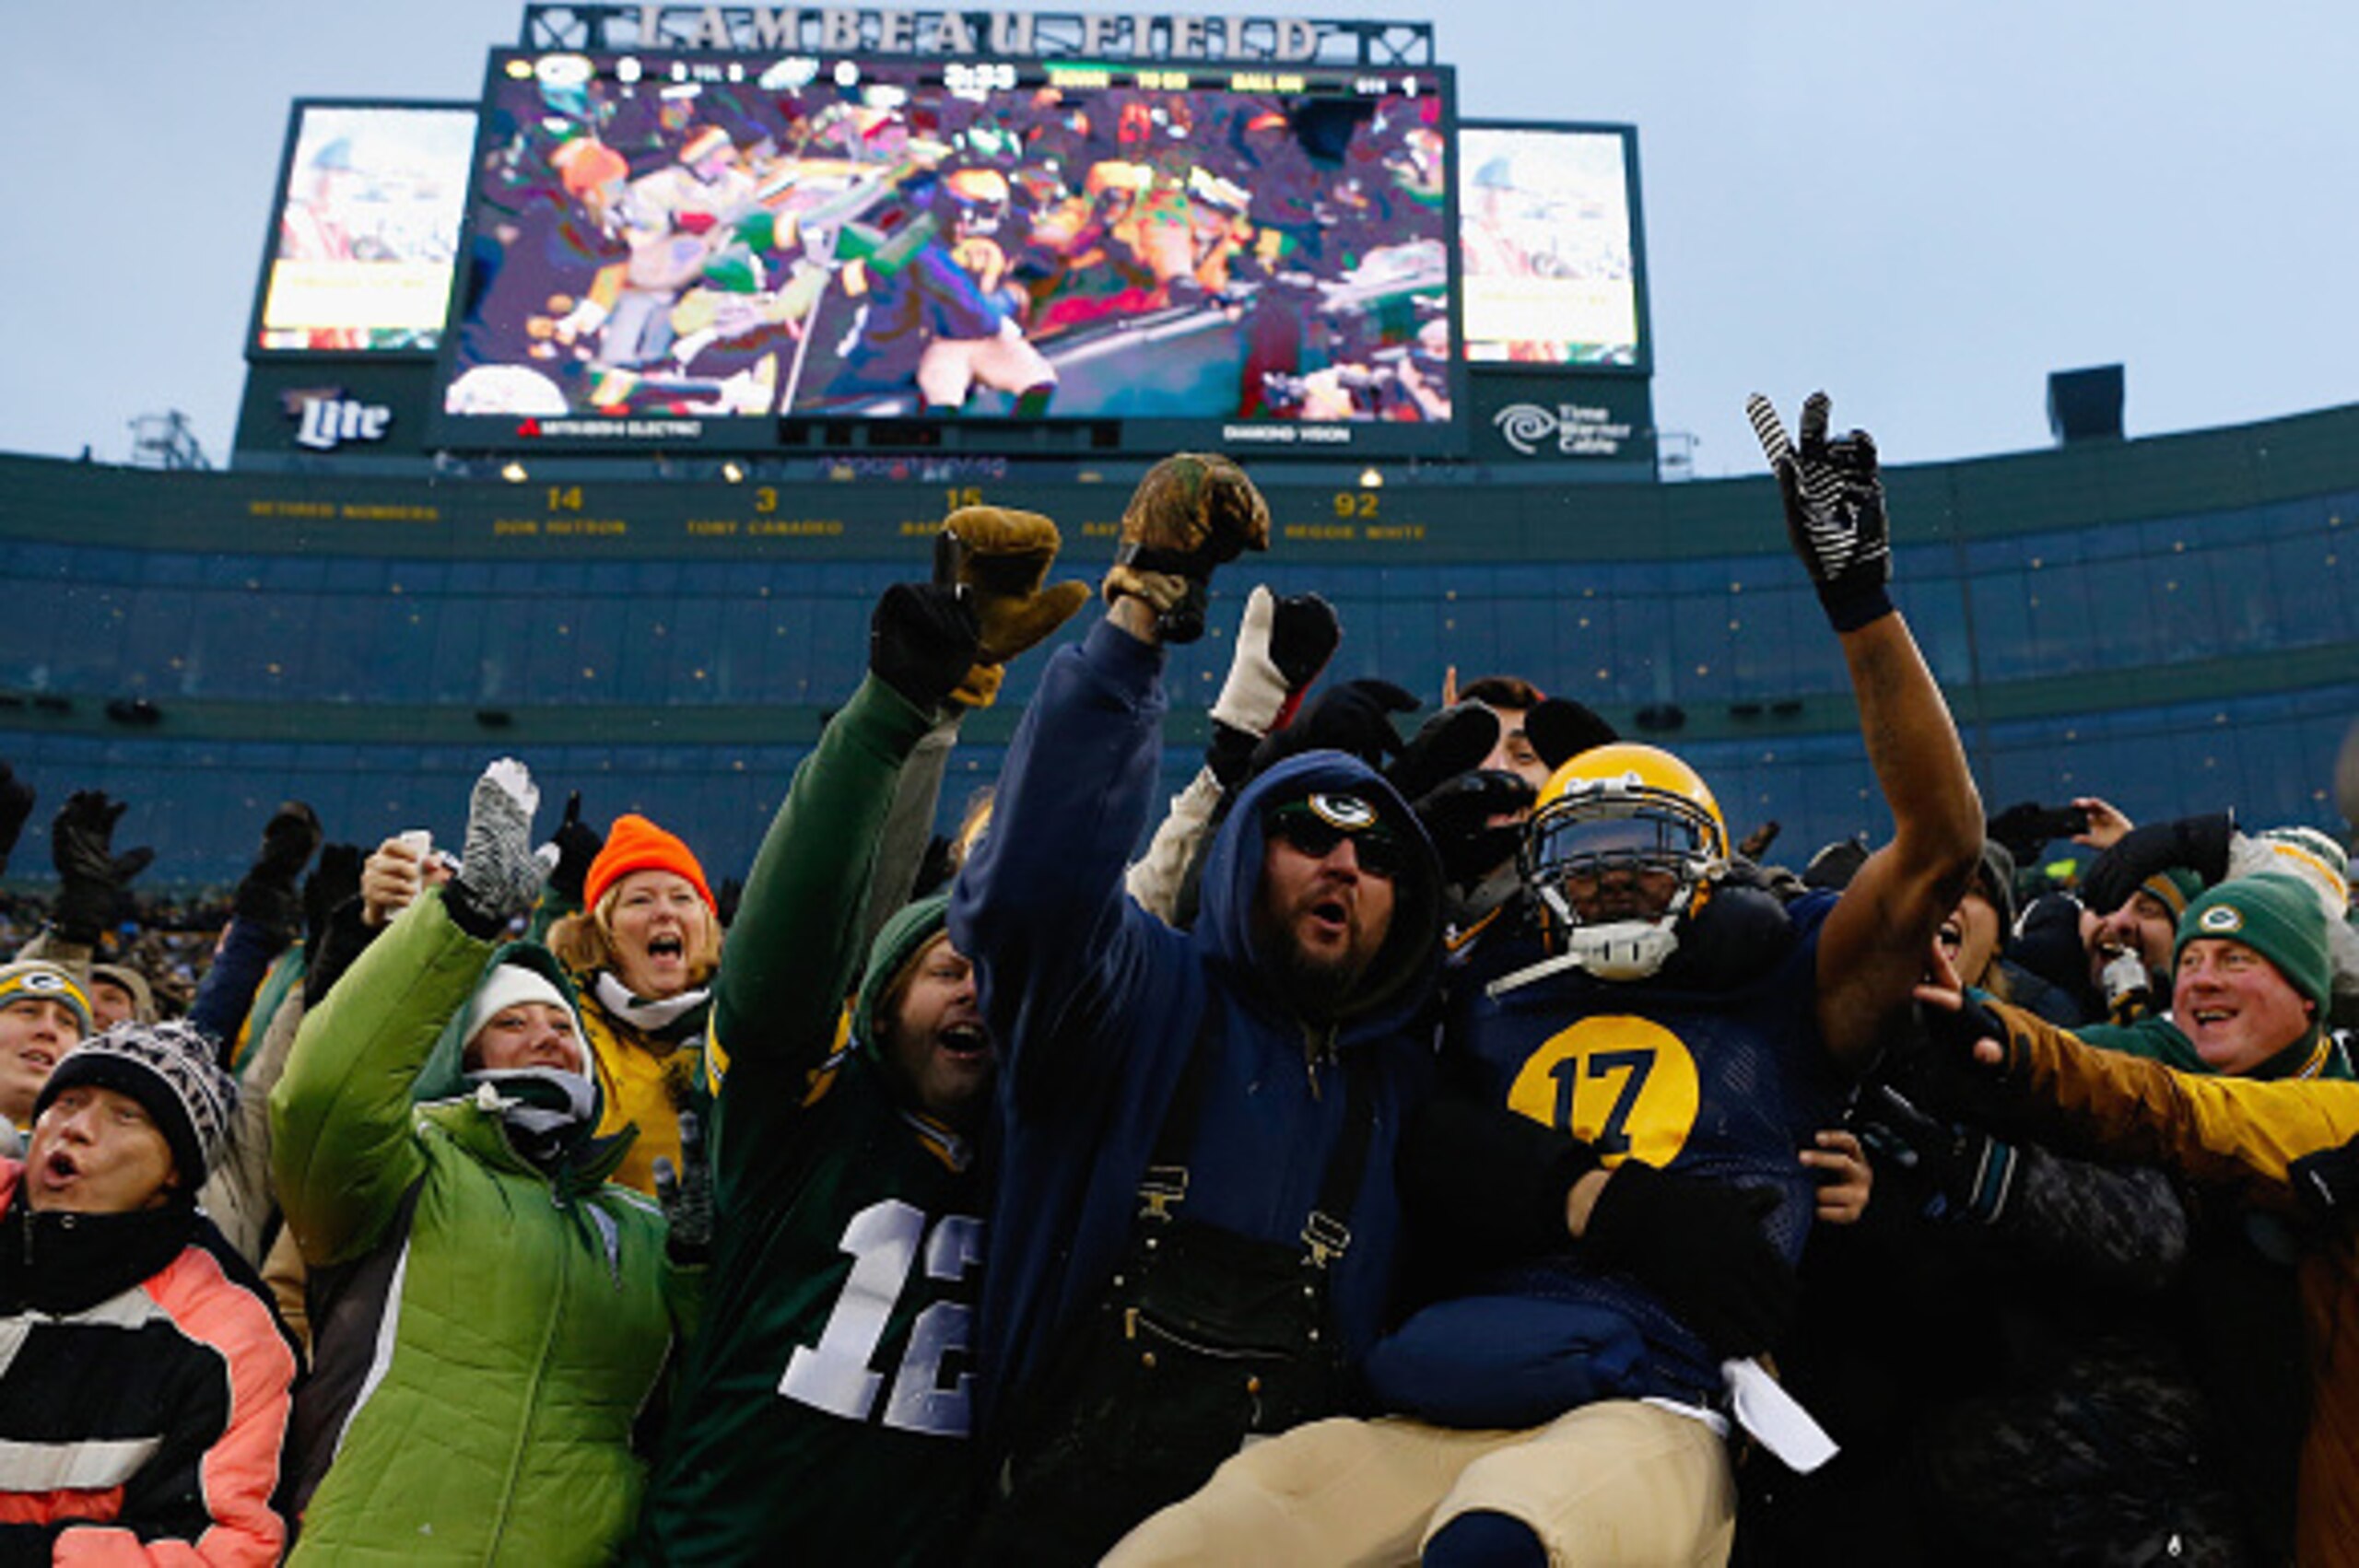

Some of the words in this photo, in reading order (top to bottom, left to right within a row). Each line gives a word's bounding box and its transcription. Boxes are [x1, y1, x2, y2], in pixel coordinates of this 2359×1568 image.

[640, 4, 1036, 55] LAMBEAU
[1082, 15, 1318, 63] FIELD
[296, 397, 390, 448] Lite
[1559, 404, 1609, 423] Time
[1560, 422, 1630, 438] Warner
[1558, 437, 1618, 454] Cable
[548, 486, 583, 511] 14
[755, 486, 778, 512] 3
[1334, 492, 1379, 518] 92
[1365, 526, 1426, 541] WHITE
[1547, 1047, 1657, 1154] 17
[778, 1199, 984, 1437] 12
